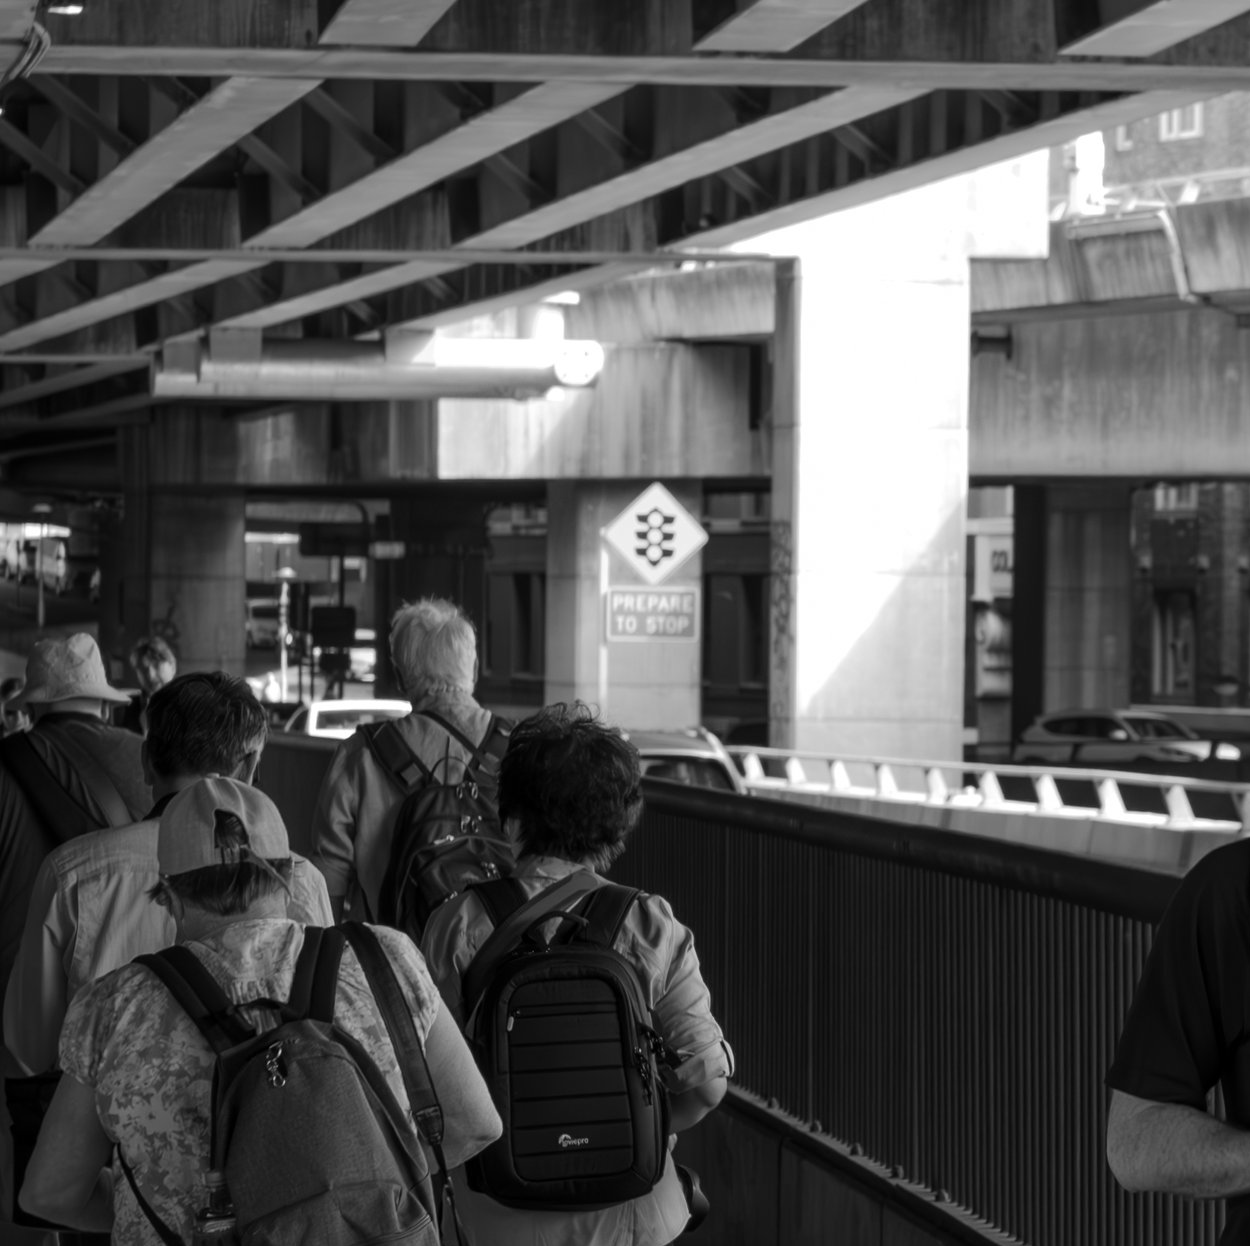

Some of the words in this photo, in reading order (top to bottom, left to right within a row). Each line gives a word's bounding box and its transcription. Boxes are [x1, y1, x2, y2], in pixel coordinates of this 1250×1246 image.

[612, 593, 694, 613] PREPARE
[616, 616, 637, 633] TO
[646, 615, 689, 634] STOP
